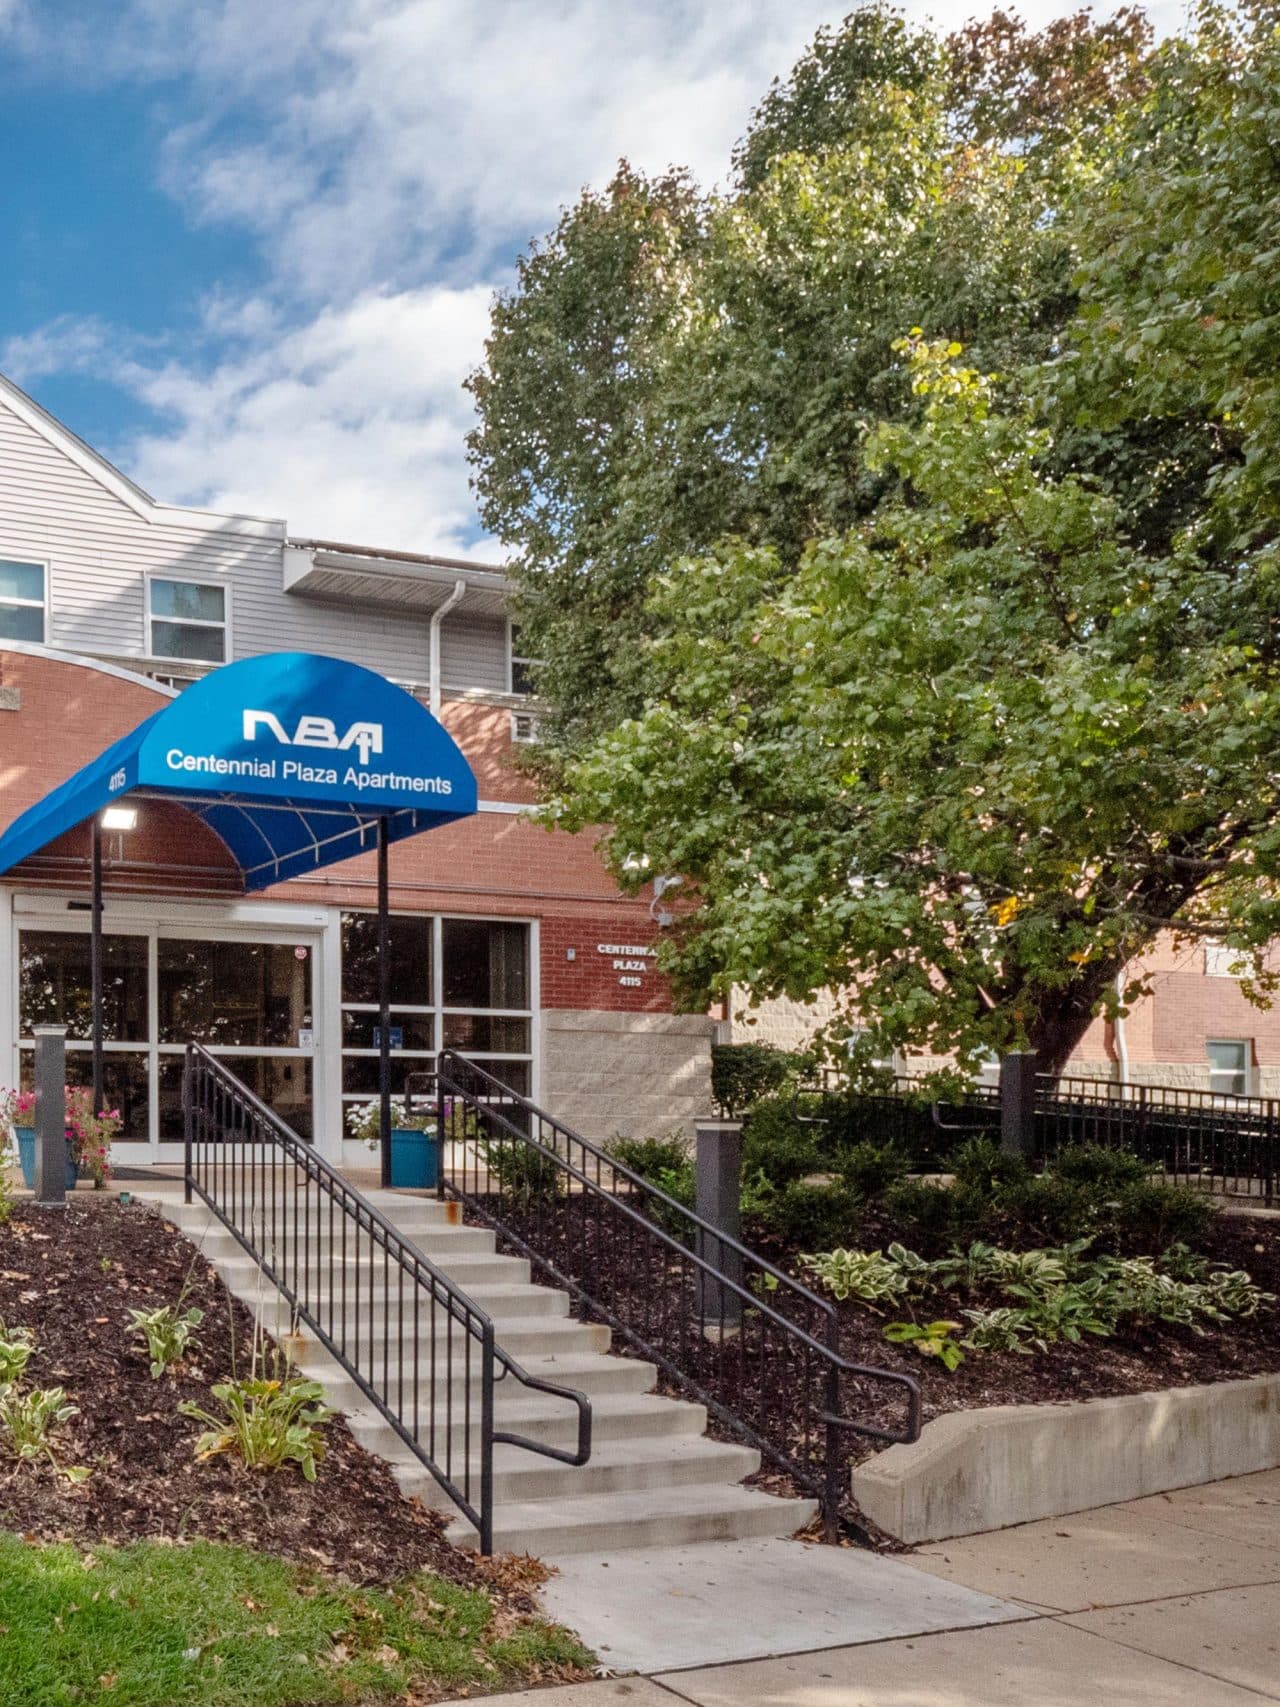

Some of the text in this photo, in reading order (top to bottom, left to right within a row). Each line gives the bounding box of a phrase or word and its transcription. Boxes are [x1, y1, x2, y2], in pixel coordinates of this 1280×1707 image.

[109, 767, 126, 792] 4115
[166, 749, 452, 795] Centennial Plaza Apartments
[613, 960, 647, 971] PLAZA
[619, 976, 641, 986] 4115
